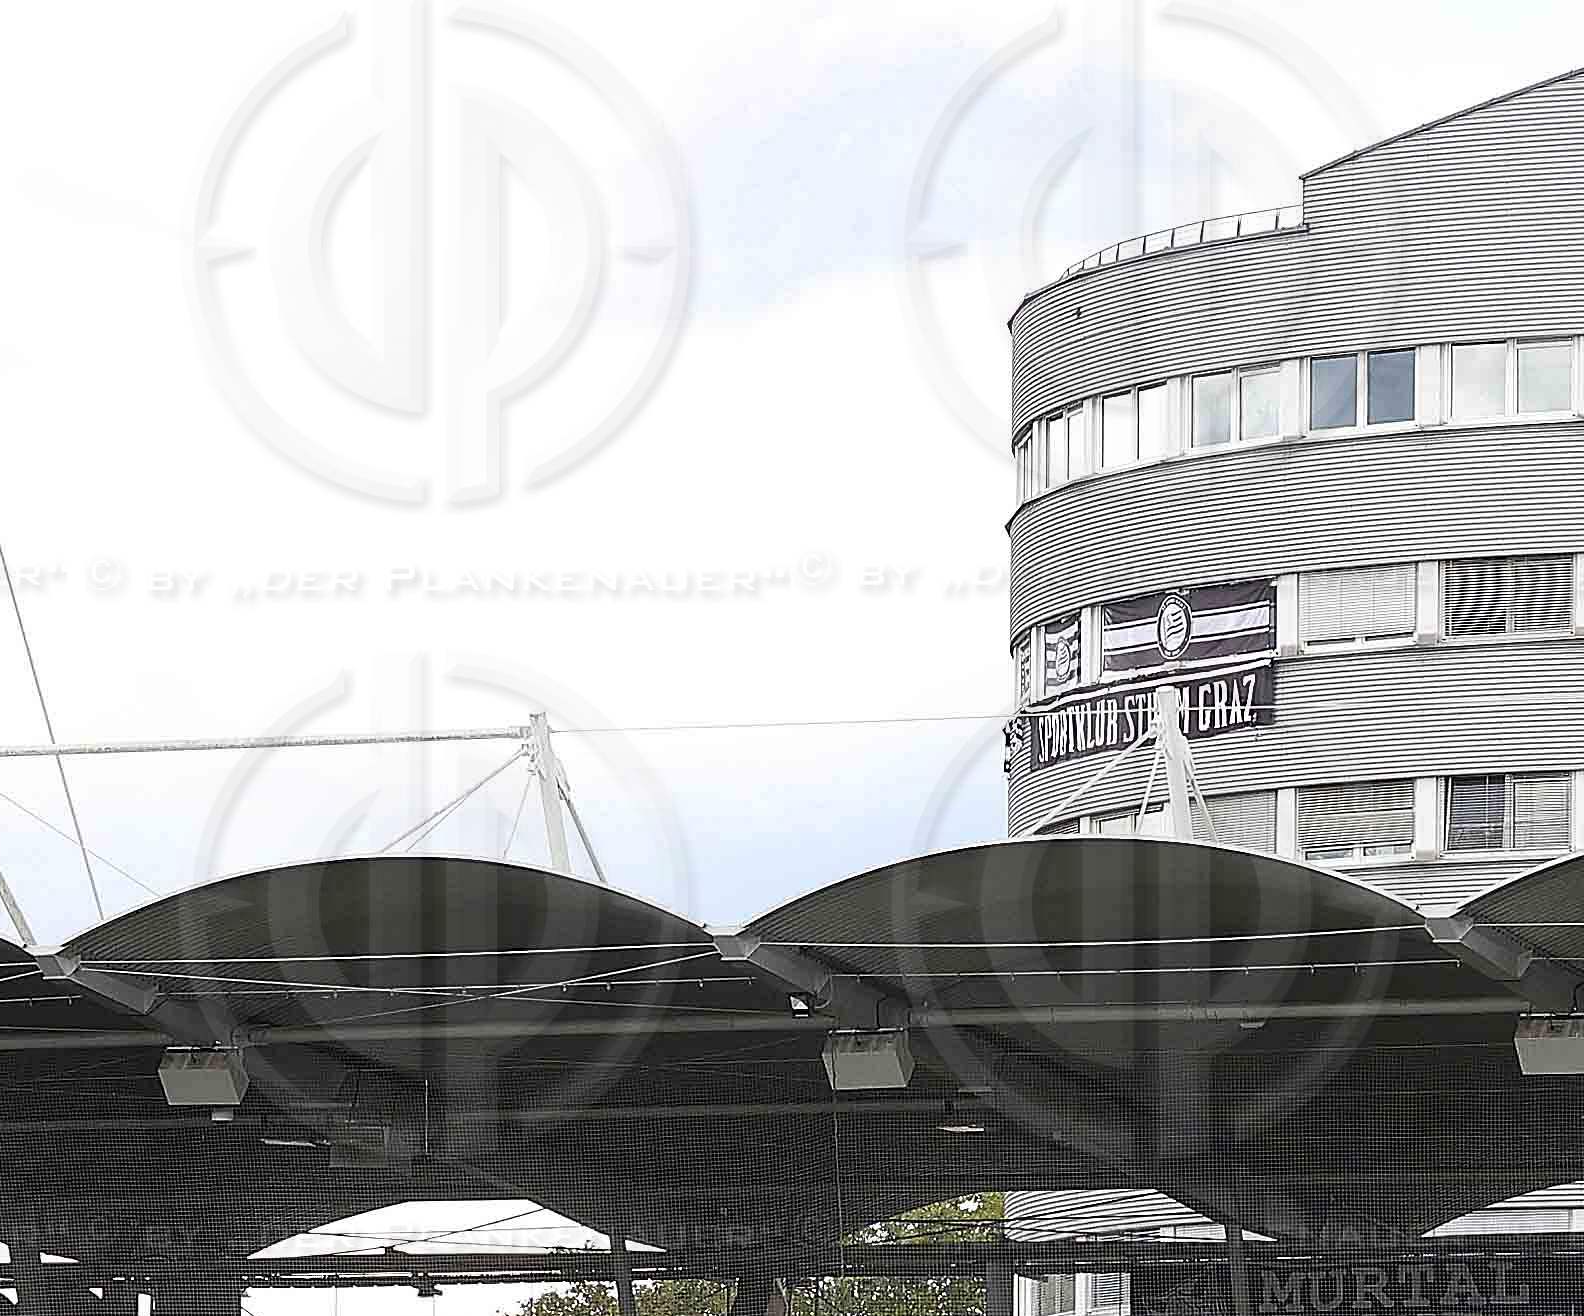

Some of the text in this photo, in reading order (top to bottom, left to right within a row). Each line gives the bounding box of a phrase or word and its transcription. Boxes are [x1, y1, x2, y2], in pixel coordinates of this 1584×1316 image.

[1038, 673, 1256, 763] SPORTKLUB STUM GRAZ
[1258, 1262, 1530, 1315] MURTAL
